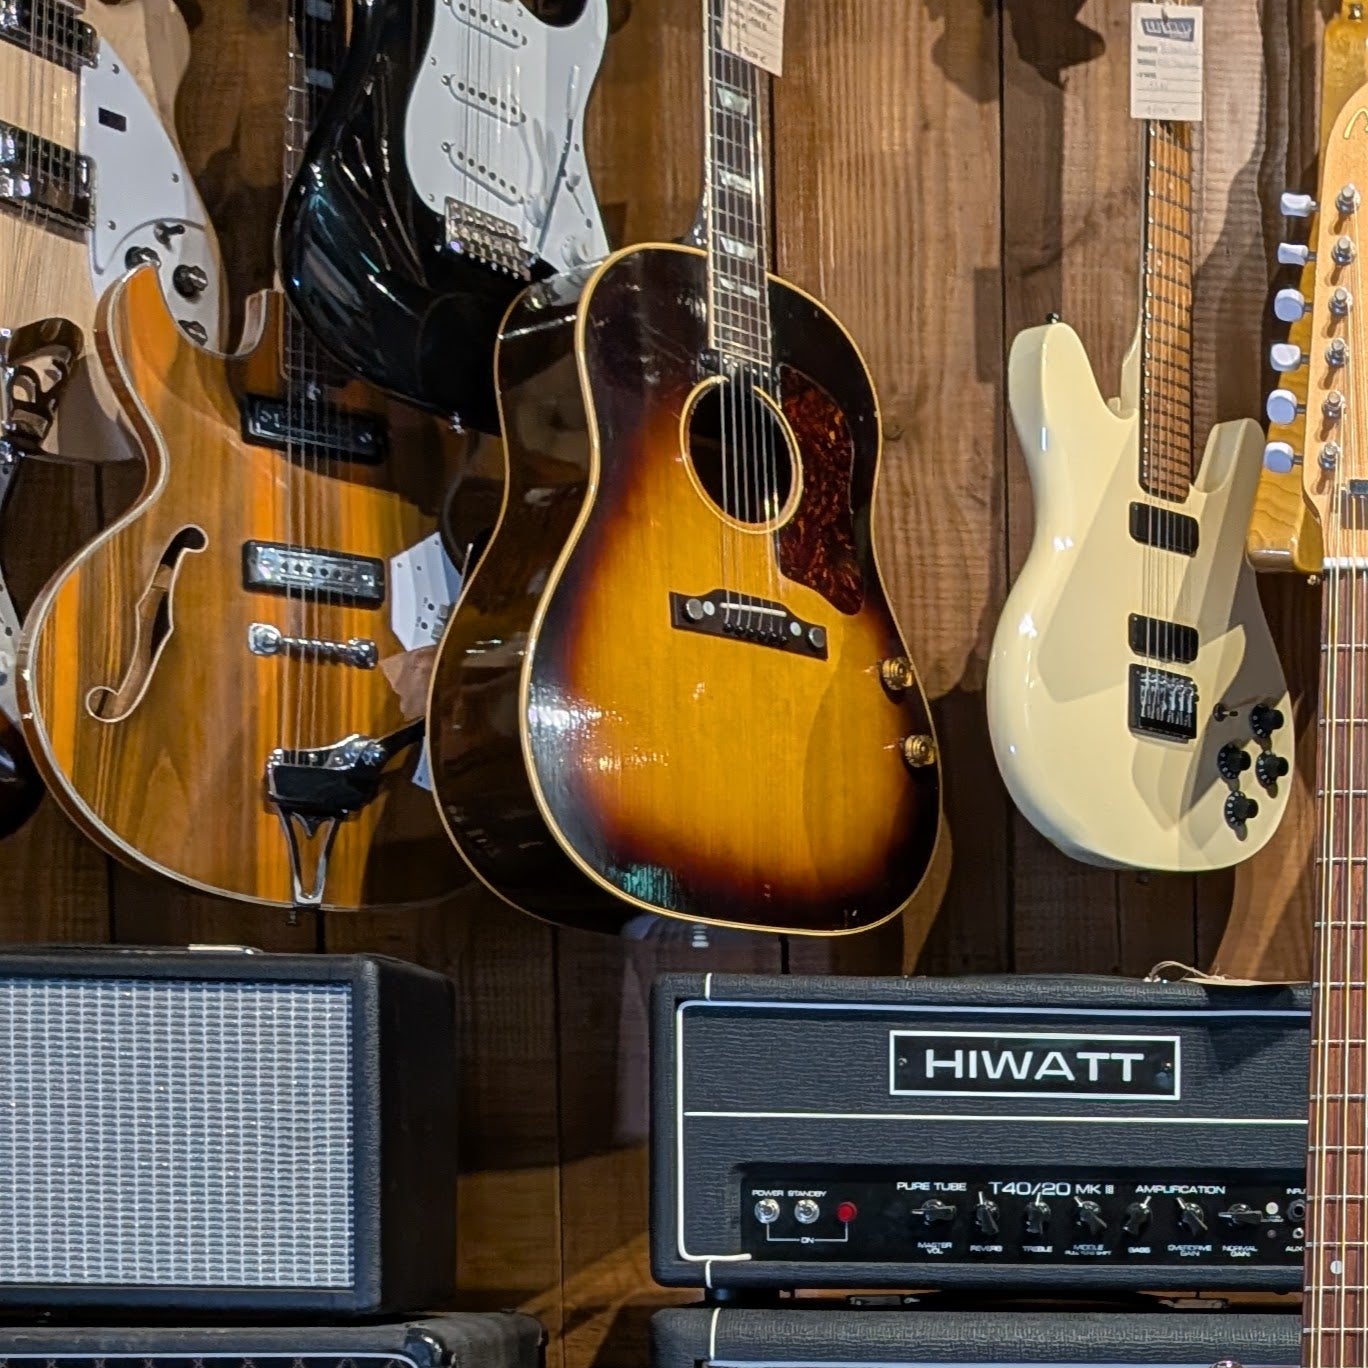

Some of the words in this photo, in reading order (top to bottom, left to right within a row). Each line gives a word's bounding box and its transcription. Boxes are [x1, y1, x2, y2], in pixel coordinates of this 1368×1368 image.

[925, 1049, 1144, 1082] HIWATT
[896, 1181, 931, 1192] PURE
[933, 1182, 967, 1192] TUBE
[988, 1181, 1071, 1196] T40/20
[1075, 1183, 1102, 1195] MK
[1135, 1184, 1226, 1195] AMPLIFICATION
[1286, 1187, 1307, 1195] INPU
[752, 1189, 784, 1197] POWER
[787, 1190, 828, 1198] STANDBY
[801, 1236, 815, 1244] ON
